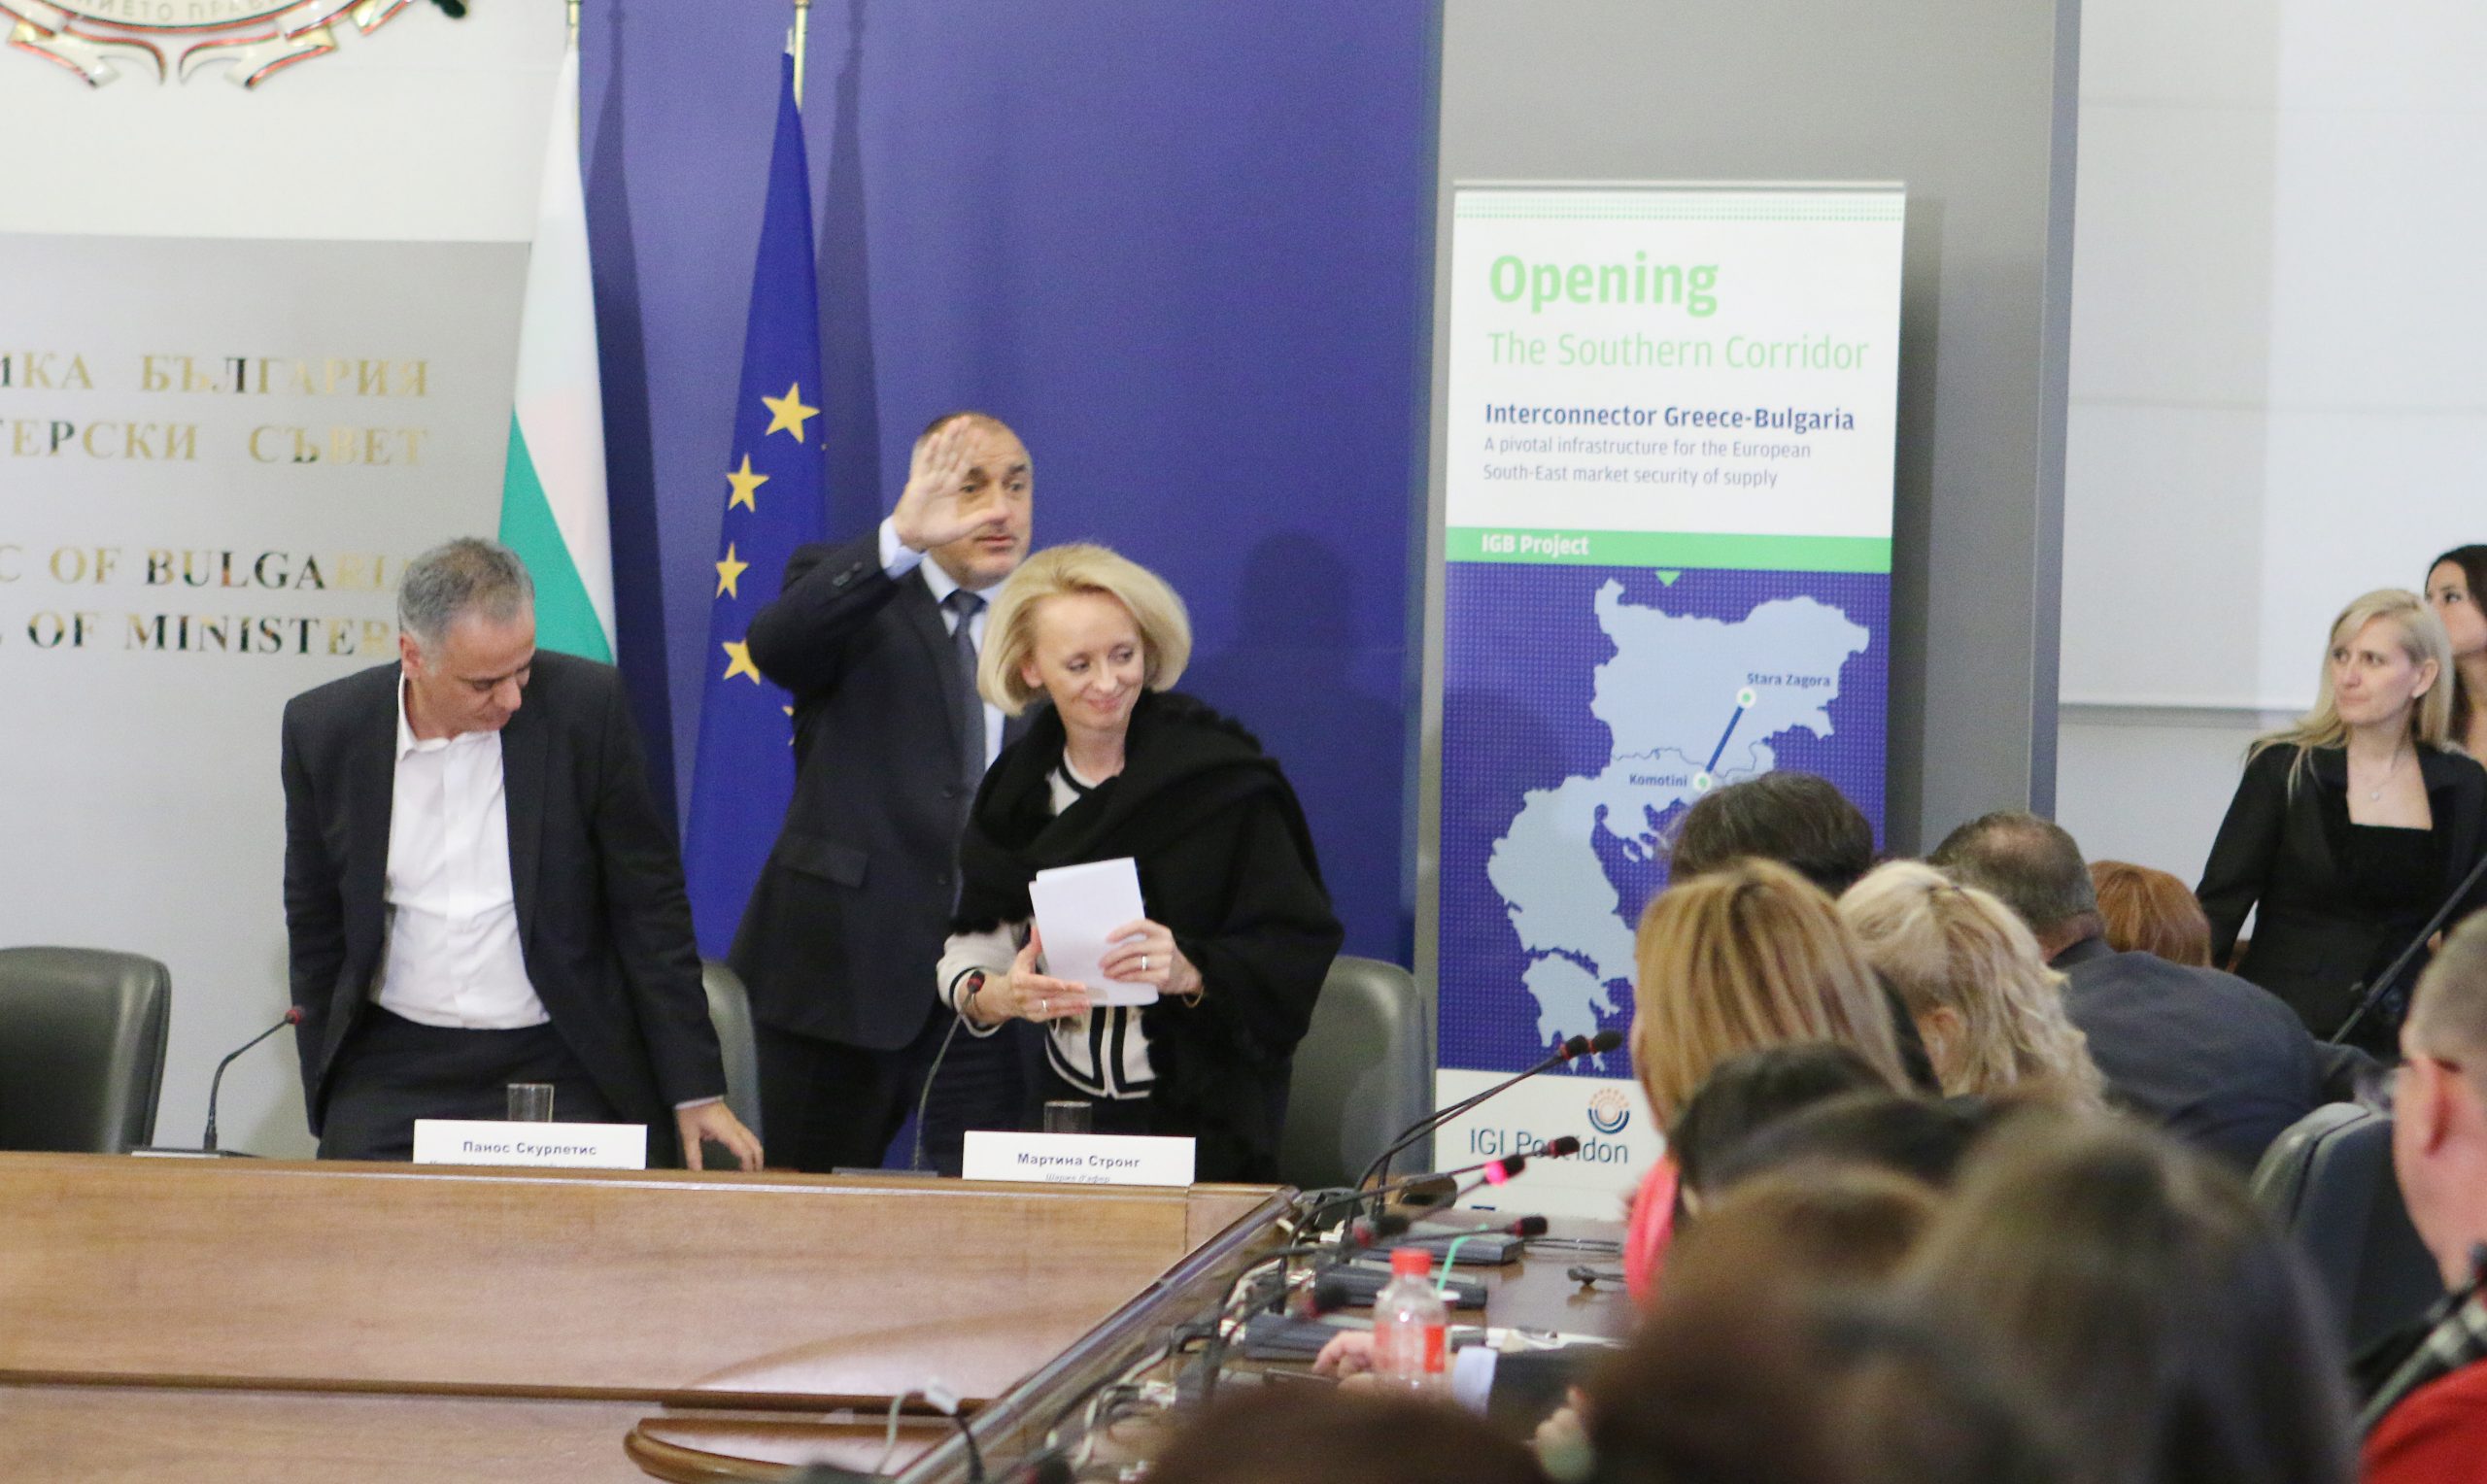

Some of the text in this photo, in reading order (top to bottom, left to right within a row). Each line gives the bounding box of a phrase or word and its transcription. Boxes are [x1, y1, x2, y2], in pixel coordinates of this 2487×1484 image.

[1489, 250, 1719, 318] Opening
[1487, 329, 1870, 370] The Southern Corridor
[141, 354, 428, 397] БЪЛГАРИЯ
[1485, 403, 1855, 434] Interconnector Greece-Bulgaria
[0, 419, 428, 466] ЕРСКИ СЪВЕТ
[1484, 436, 1812, 460] A pivotal infrastructure for the European
[1483, 463, 1778, 489] South-East market security of supply
[1482, 533, 1589, 559] IGB Project
[50, 546, 121, 586] OF
[145, 548, 408, 590] BULGARI
[27, 610, 101, 650] OF
[1747, 672, 1830, 689] Stara Zagora
[1629, 773, 1687, 787] Komotini
[462, 1140, 597, 1157] Панос Скурлетис
[1017, 1153, 1141, 1169] Мартина Стронг
[1470, 1128, 1628, 1164] IGI Podon
